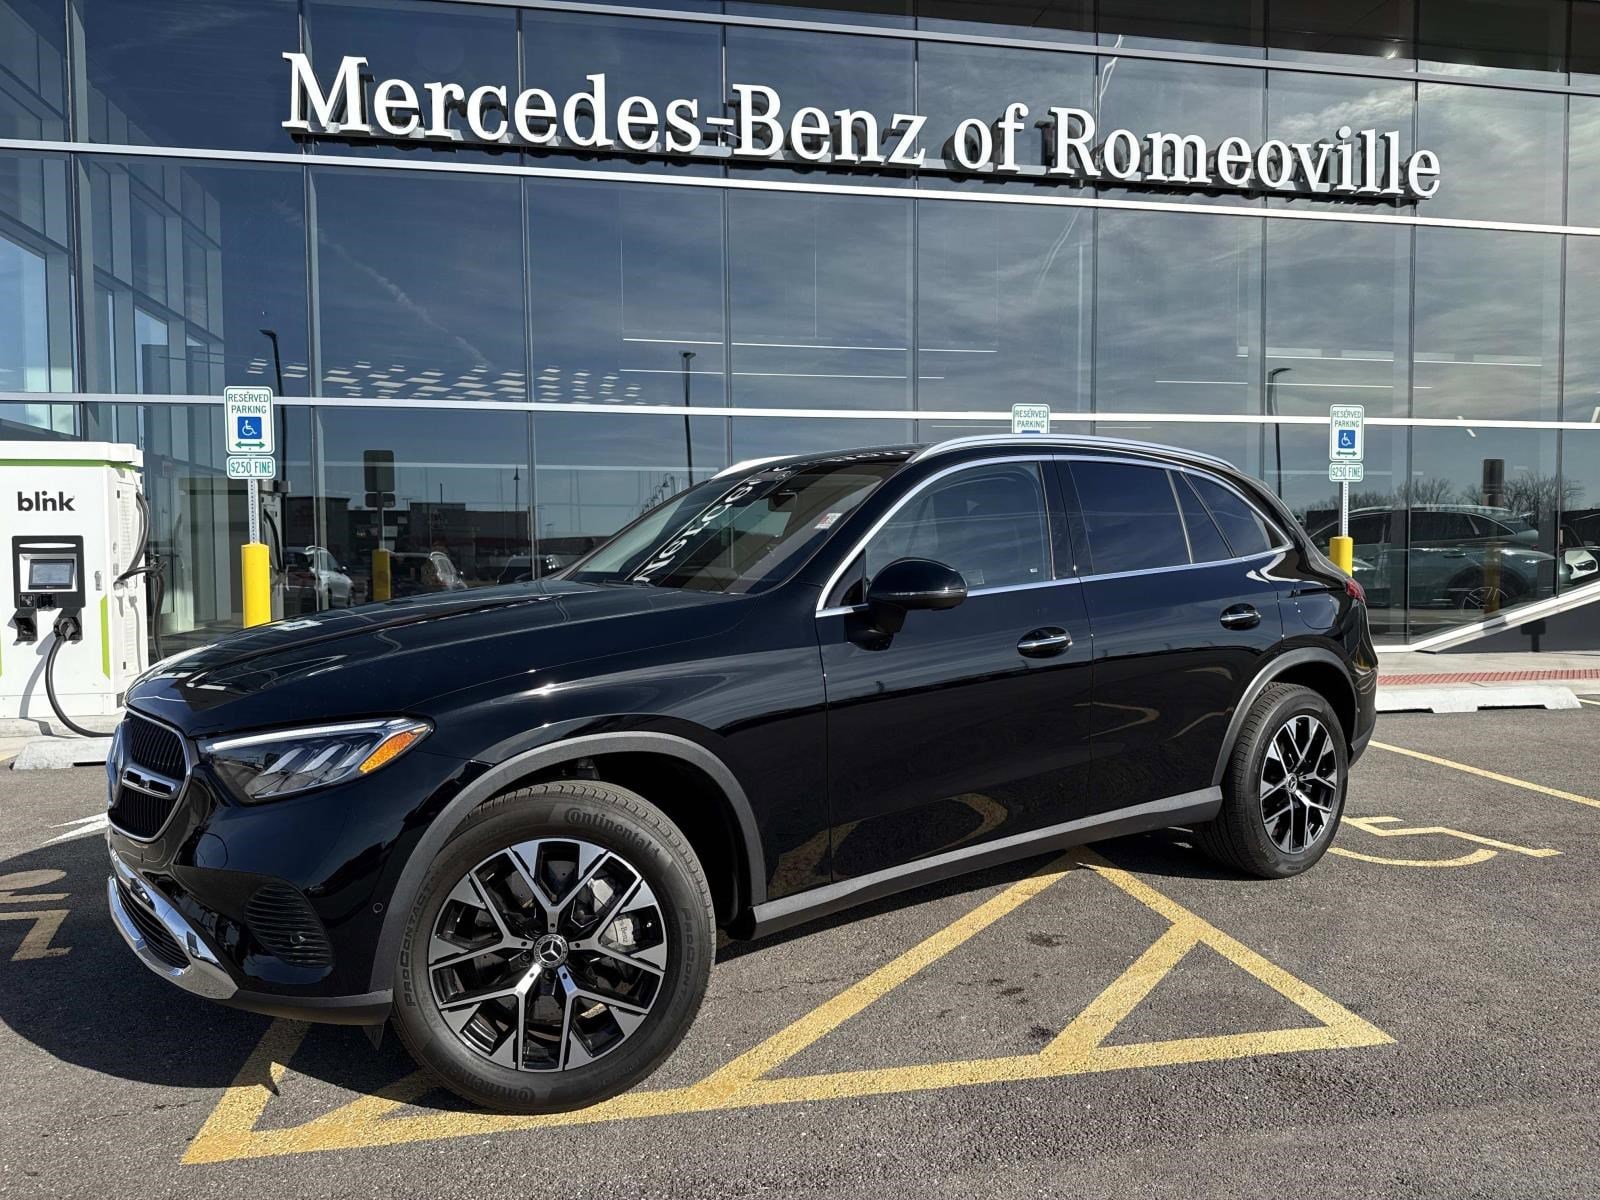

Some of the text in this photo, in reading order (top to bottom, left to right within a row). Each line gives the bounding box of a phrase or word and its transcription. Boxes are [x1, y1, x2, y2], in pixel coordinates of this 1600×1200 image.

[282, 52, 1441, 198] Mercedes-Benz of Romeoville
[228, 393, 269, 403] RESERVED
[231, 405, 267, 414] PARKING
[1015, 409, 1047, 418] RESERVED
[1332, 410, 1362, 419] RESERVED
[1017, 420, 1045, 429] PARKING
[1334, 420, 1360, 428] PARKING
[230, 461, 272, 474] $250 FINE
[1332, 467, 1361, 478] $250 FINE
[17, 490, 75, 512] blink
[564, 807, 655, 854] Continental
